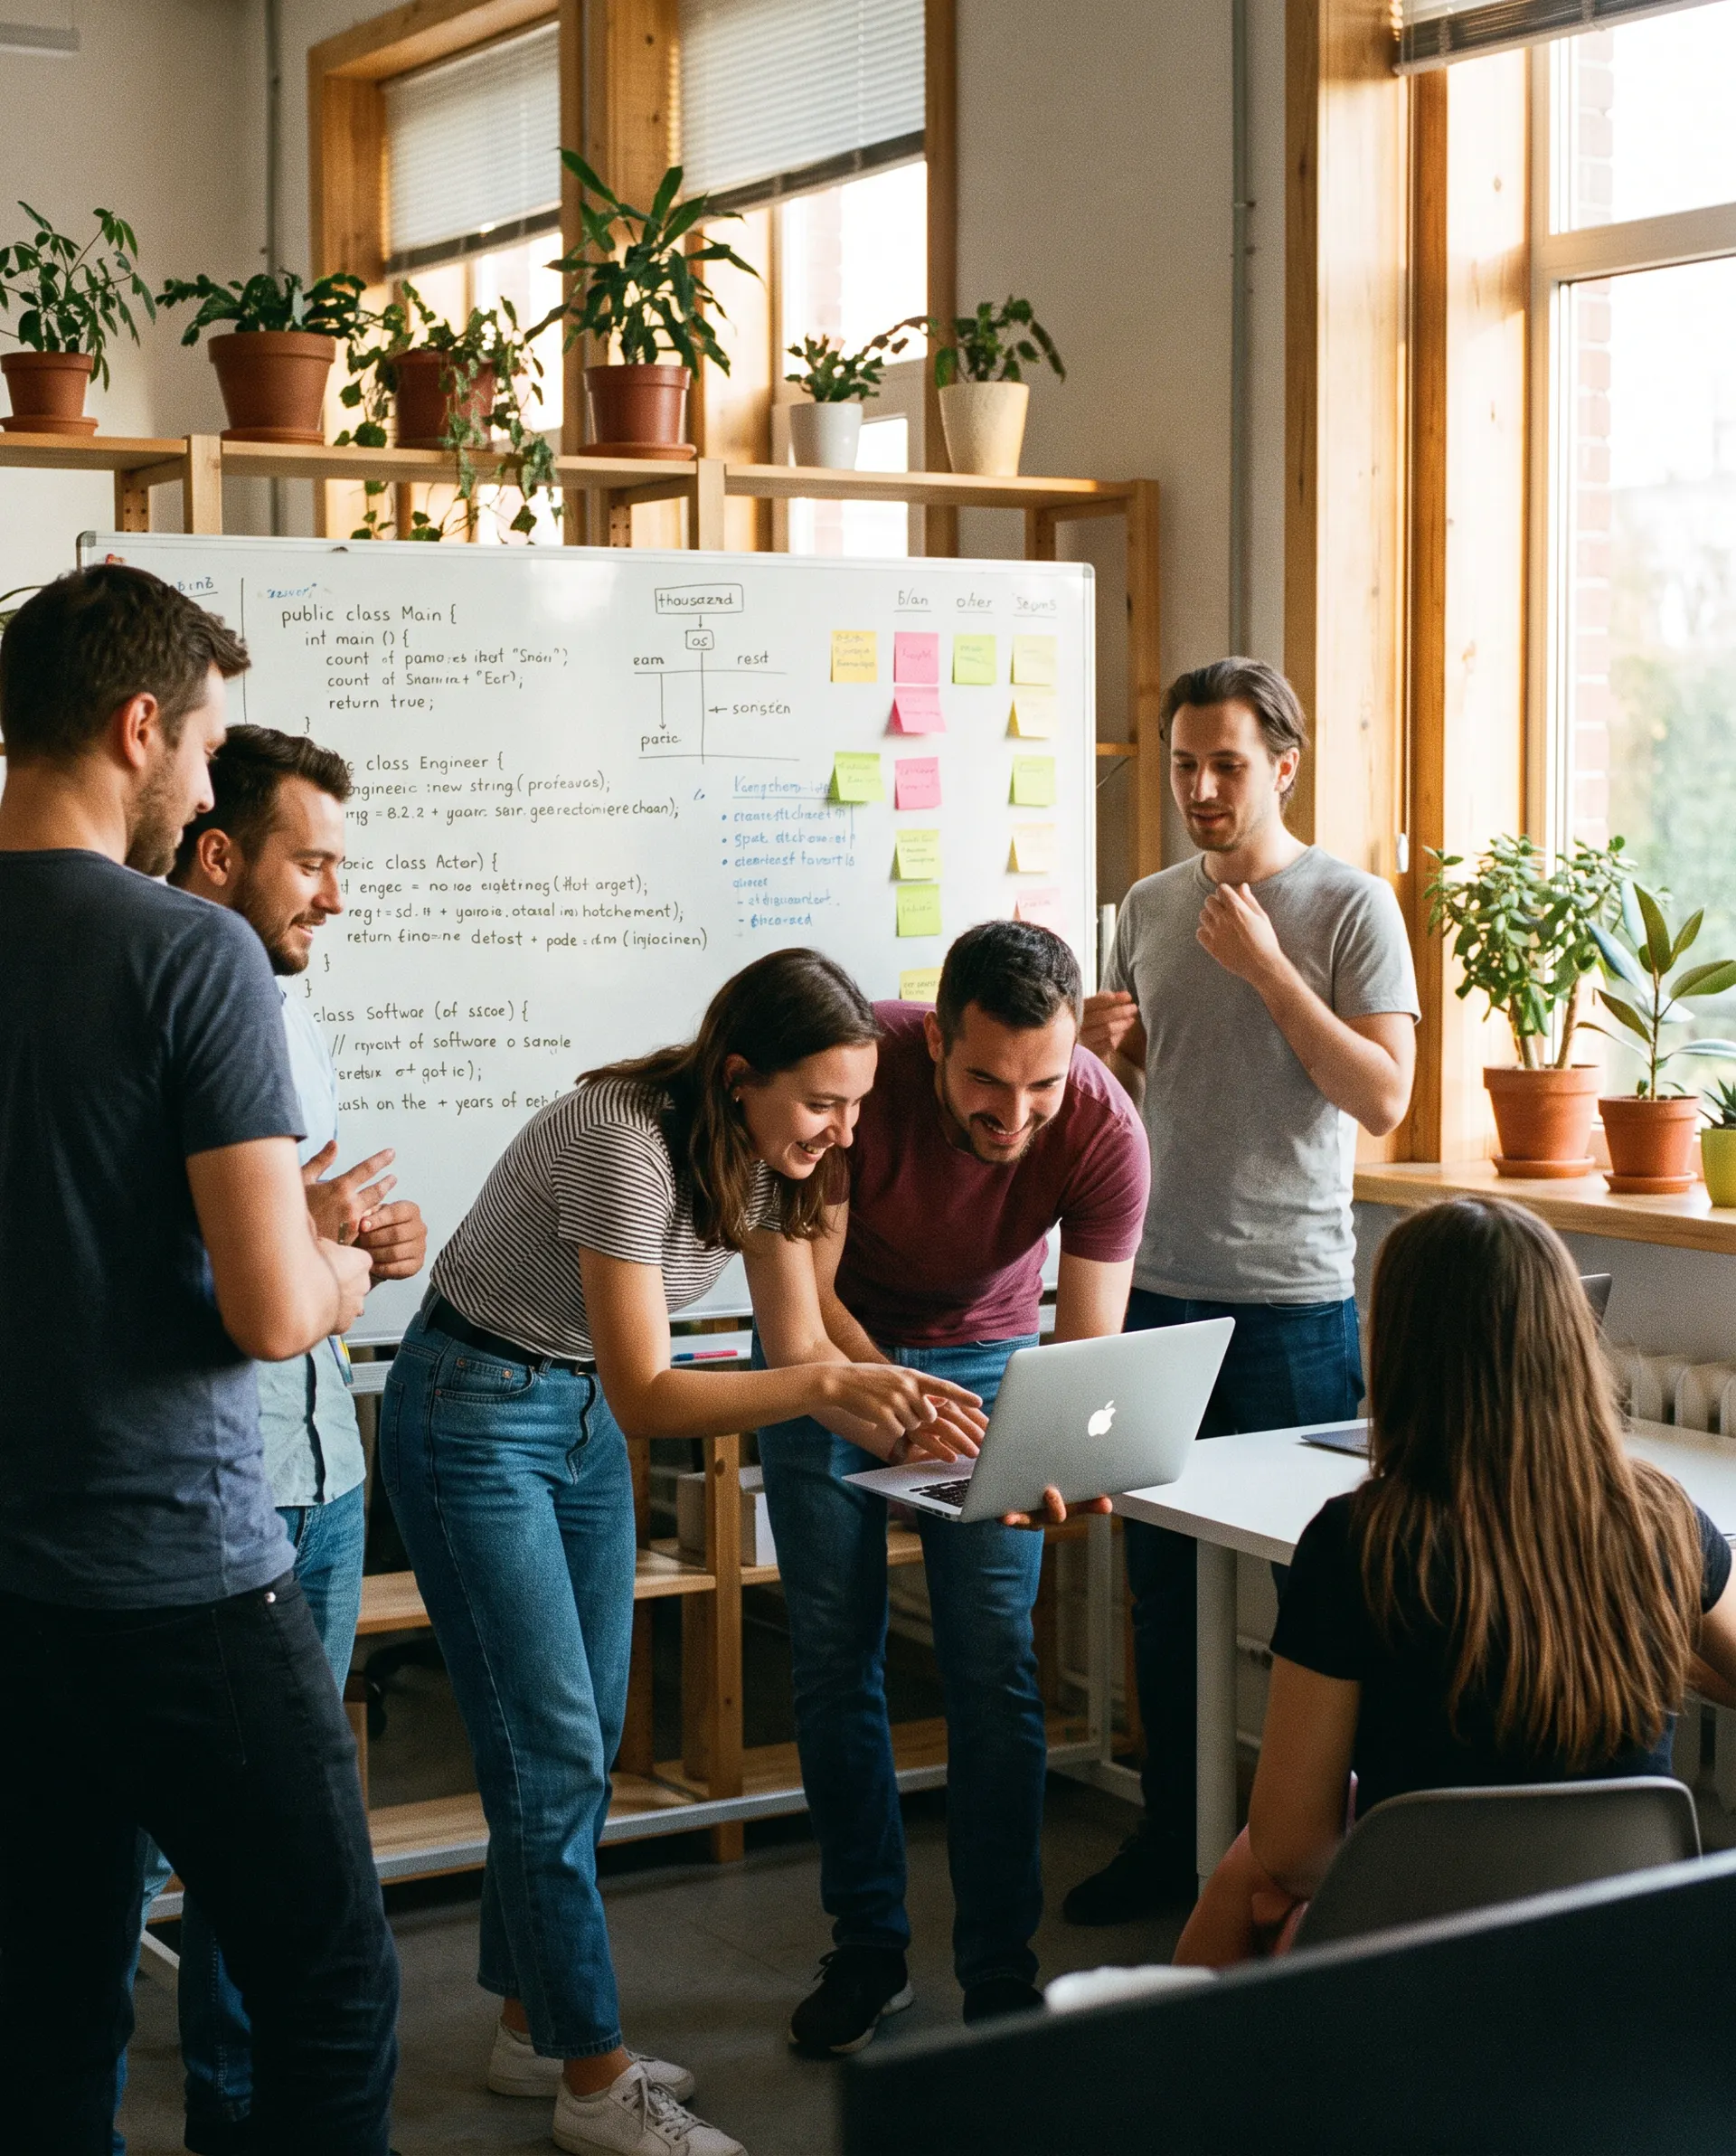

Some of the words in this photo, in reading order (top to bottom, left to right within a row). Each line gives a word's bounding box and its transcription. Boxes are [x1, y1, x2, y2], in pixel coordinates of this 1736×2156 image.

[281, 603, 335, 629] public
[345, 603, 392, 622] class
[401, 605, 442, 622] Main
[305, 629, 327, 647] int
[335, 635, 374, 646] main
[326, 650, 370, 667] count
[326, 672, 370, 688] count
[329, 694, 380, 711] return
[390, 693, 434, 712] true;
[420, 755, 489, 776] Engineer
[386, 805, 425, 820] 8.2.2
[385, 853, 427, 871] class
[346, 929, 392, 944] return
[409, 1032, 424, 1050] of
[376, 1100, 395, 1111] on
[401, 1092, 427, 1111] the
[455, 1097, 494, 1117] years
[501, 1090, 518, 1109] of
